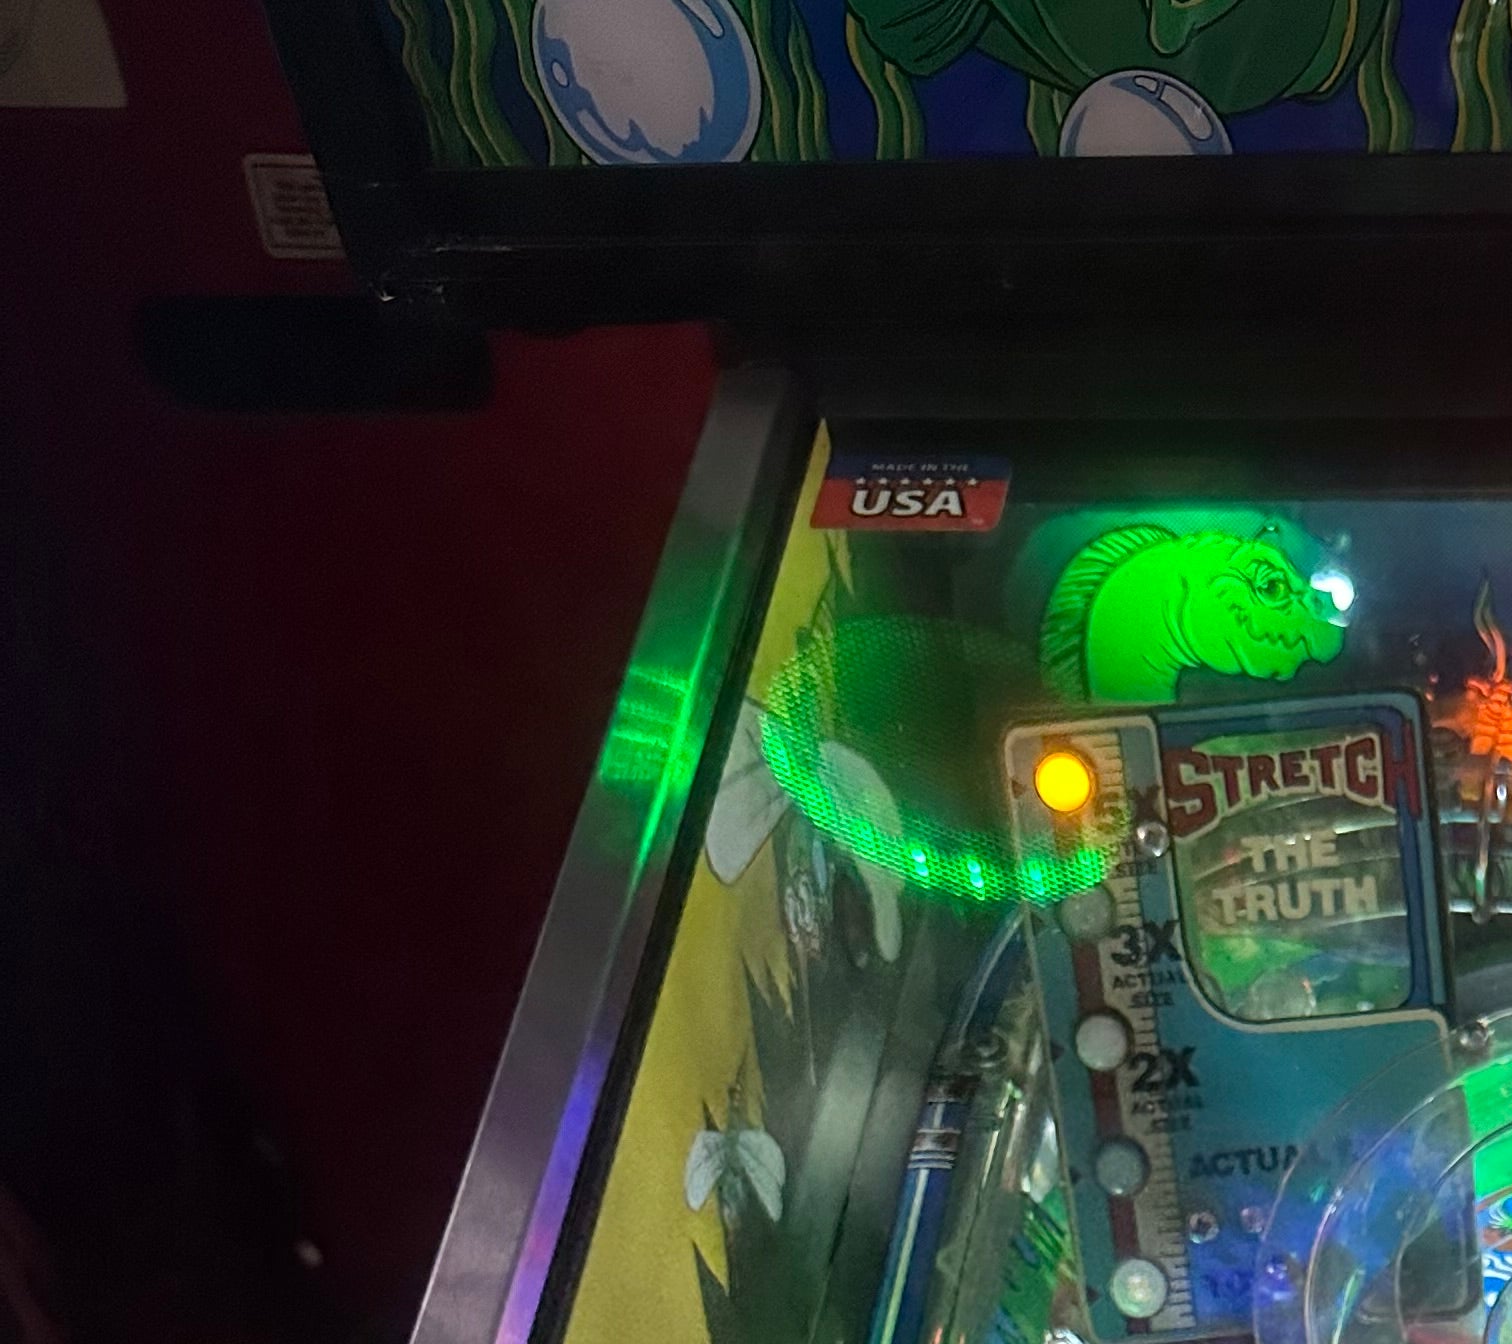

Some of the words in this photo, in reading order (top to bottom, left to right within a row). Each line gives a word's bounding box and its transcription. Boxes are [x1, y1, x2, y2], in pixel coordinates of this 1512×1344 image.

[852, 489, 963, 516] USA
[1163, 719, 1421, 838] STRETCH
[1241, 829, 1340, 873] THE
[1212, 875, 1378, 925] TRUTH
[1111, 919, 1182, 967] 3X
[1127, 1046, 1200, 1093] 2X
